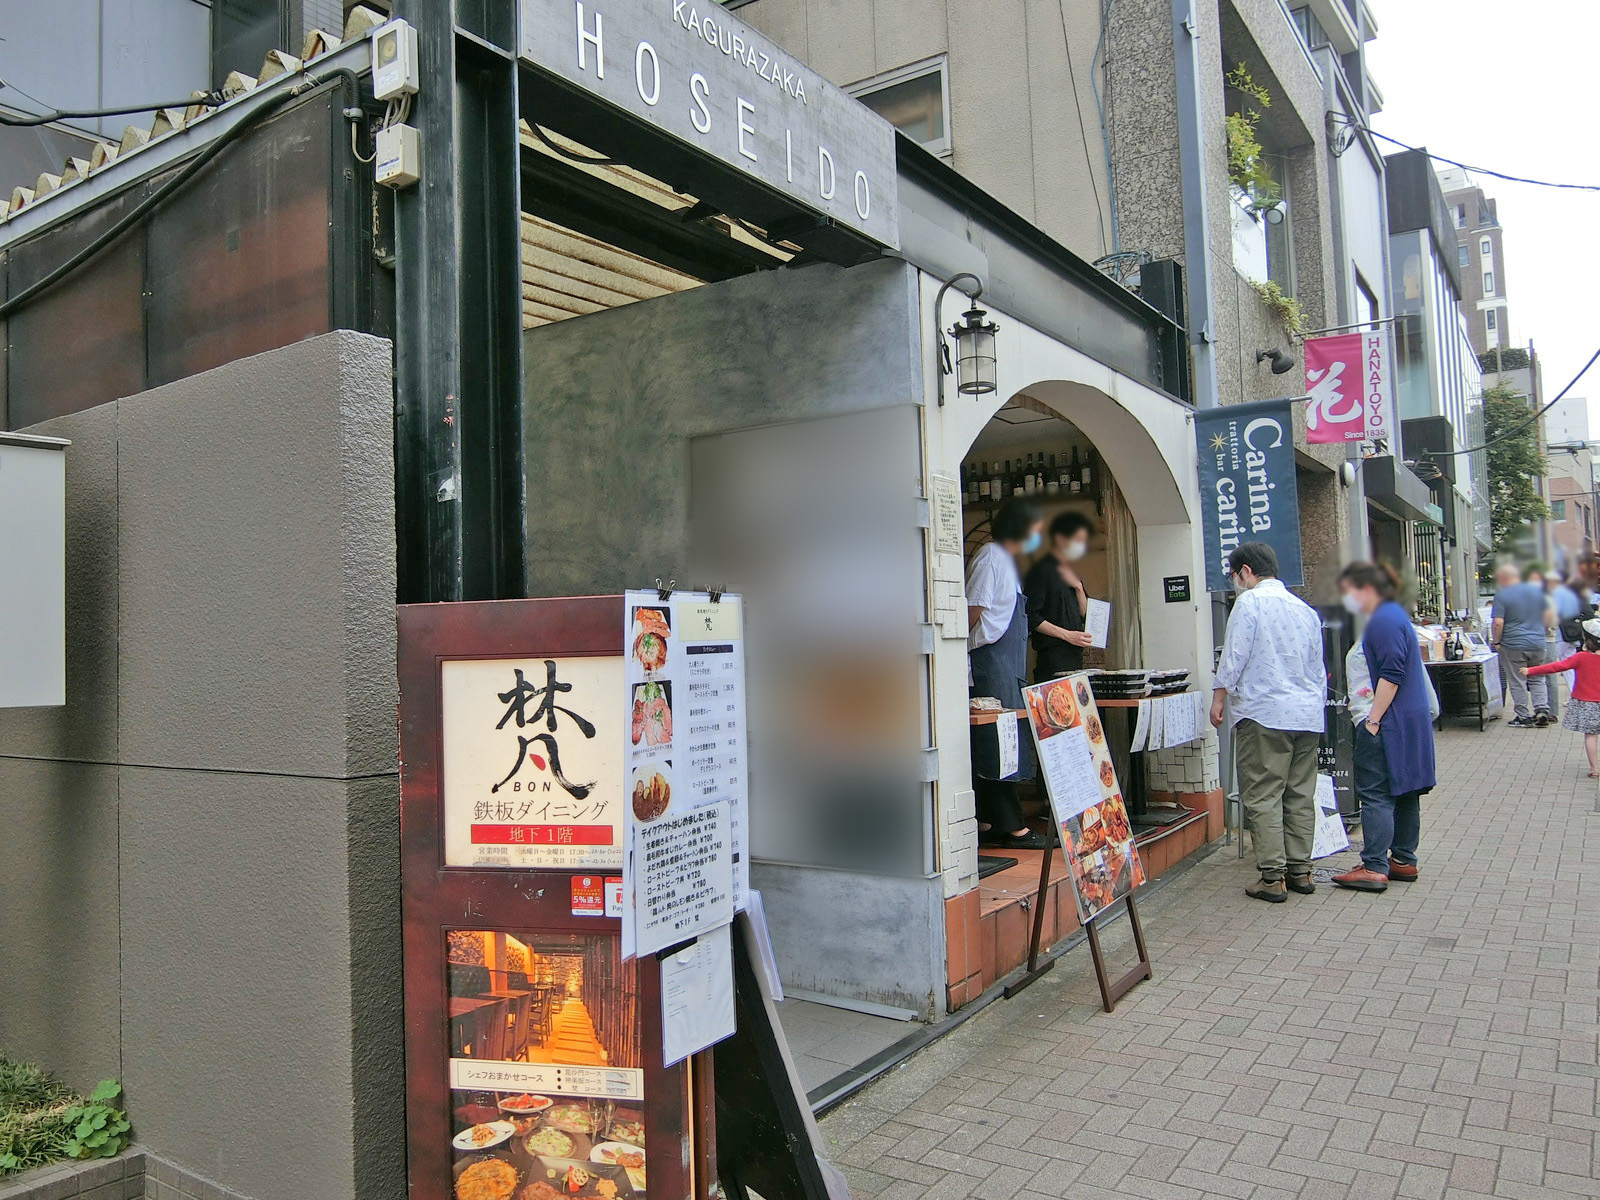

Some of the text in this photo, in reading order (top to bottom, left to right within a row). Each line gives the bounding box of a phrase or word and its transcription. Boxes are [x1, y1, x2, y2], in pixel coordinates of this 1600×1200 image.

[672, 0, 807, 105] KAGURAZAKA
[576, 1, 871, 221] HOSEIDO
[1368, 337, 1383, 427] HANATOYO
[1306, 361, 1363, 430] 花
[1344, 429, 1386, 439] Since 1835
[1229, 421, 1242, 470] trattoria
[1216, 453, 1226, 472] bar
[1243, 417, 1283, 534] Carina
[513, 781, 552, 792] BON
[473, 800, 609, 822] 鉄板ダイニング
[509, 827, 573, 843] 地下1階
[573, 896, 601, 904] 5%還元
[467, 1070, 544, 1083] シェフおまかせコース
